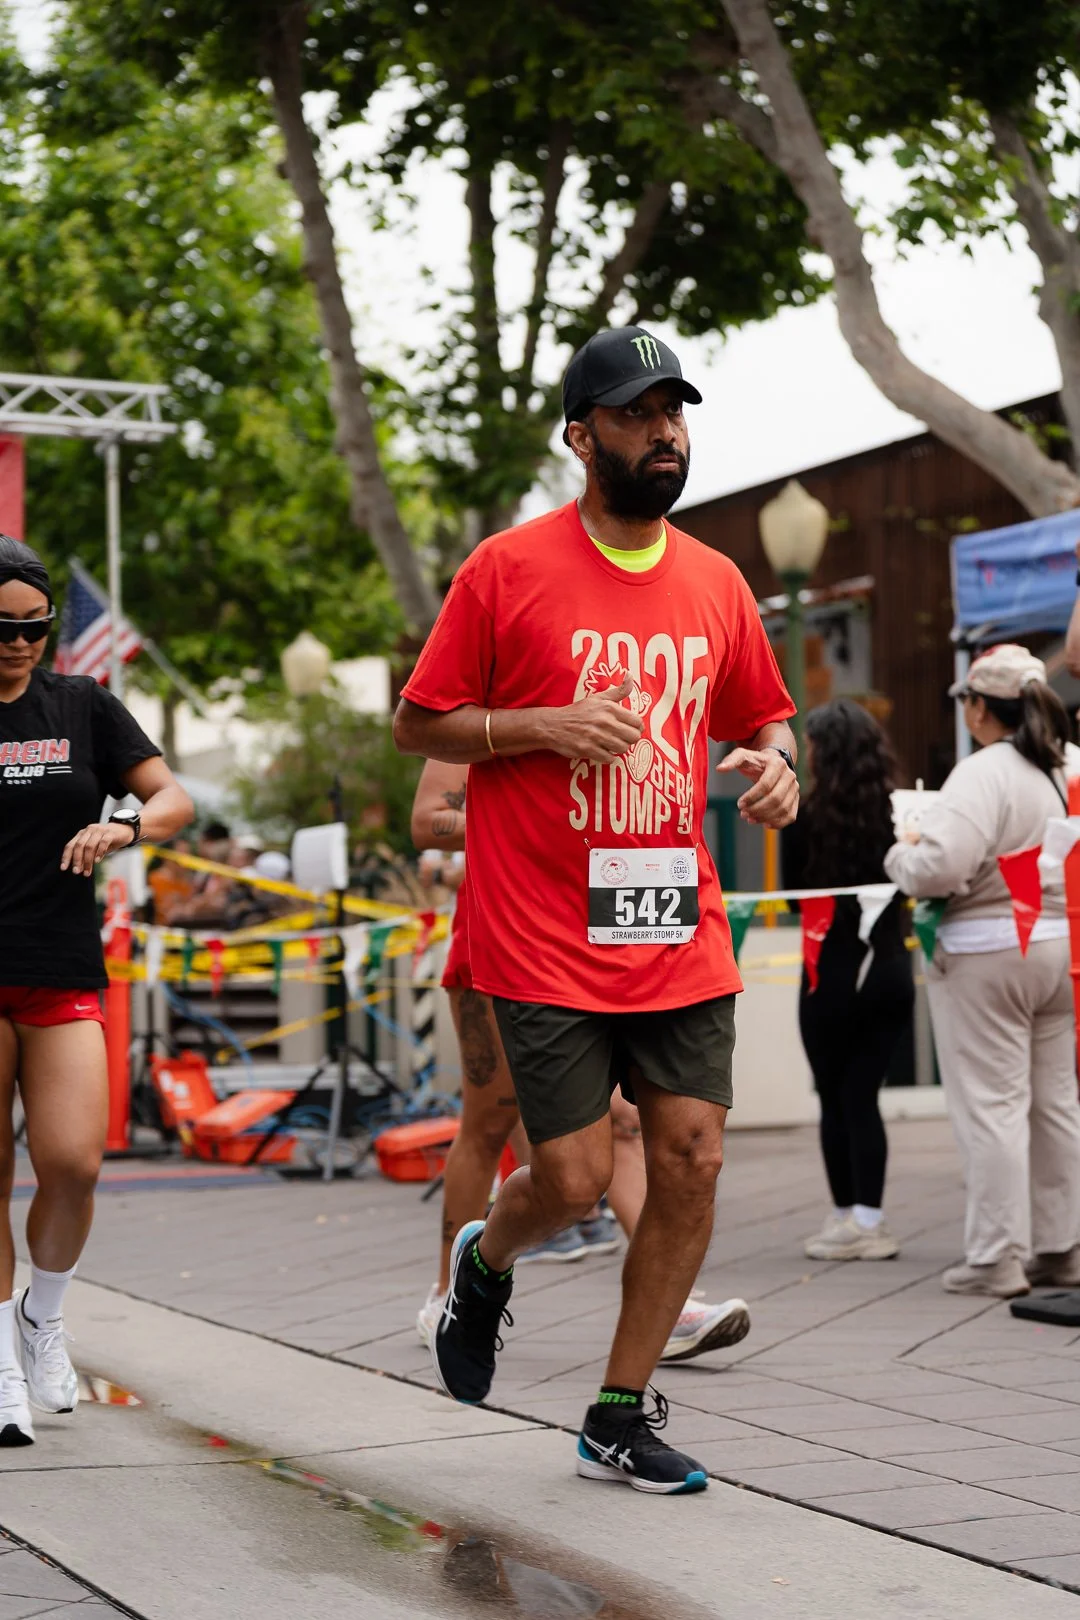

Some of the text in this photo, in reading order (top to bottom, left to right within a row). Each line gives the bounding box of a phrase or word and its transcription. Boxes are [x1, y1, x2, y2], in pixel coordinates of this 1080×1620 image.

[0, 739, 70, 765] HEIM
[3, 765, 45, 777] CLUB
[569, 754, 671, 835] STOMP
[615, 888, 682, 926] 542
[611, 930, 684, 940] STRAWBERRY STOMP 5K
